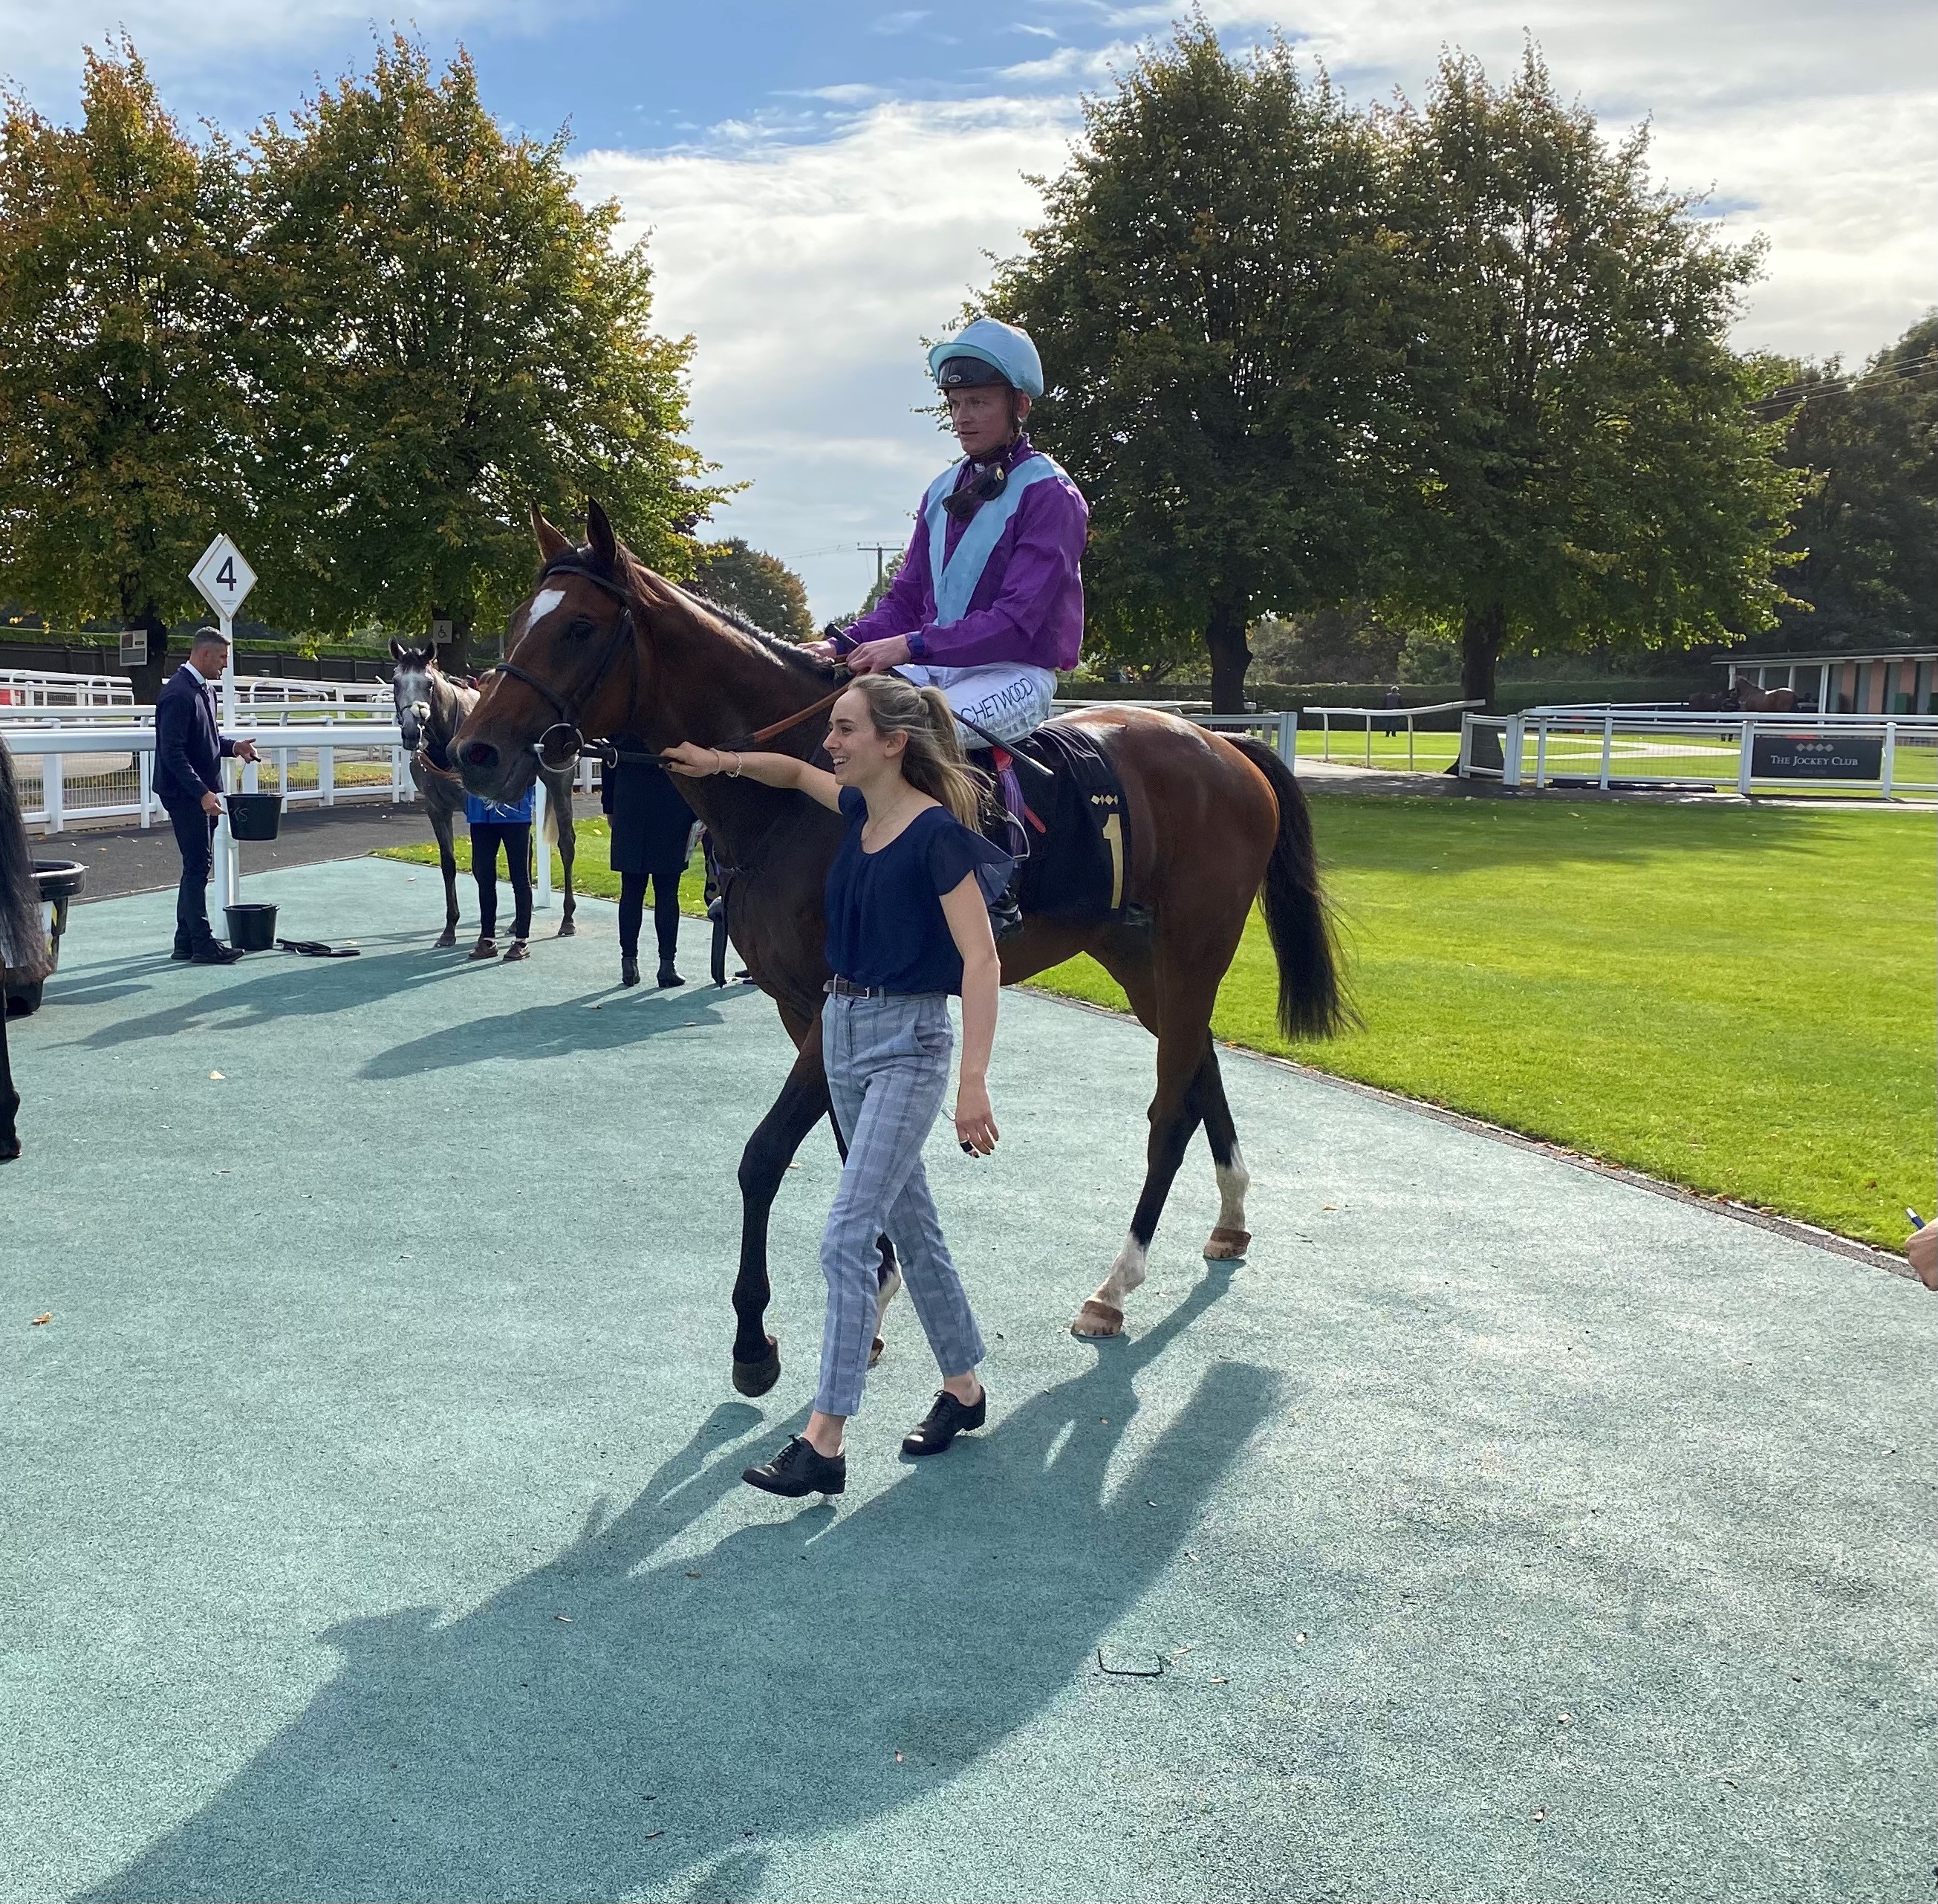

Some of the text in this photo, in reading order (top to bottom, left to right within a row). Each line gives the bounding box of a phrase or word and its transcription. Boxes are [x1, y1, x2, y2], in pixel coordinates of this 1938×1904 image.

[216, 556, 237, 591] 4
[960, 678, 1033, 724] CHETWOOD
[1770, 755, 1859, 767] THE JOCKEY CLUB
[1102, 813, 1124, 909] 1
